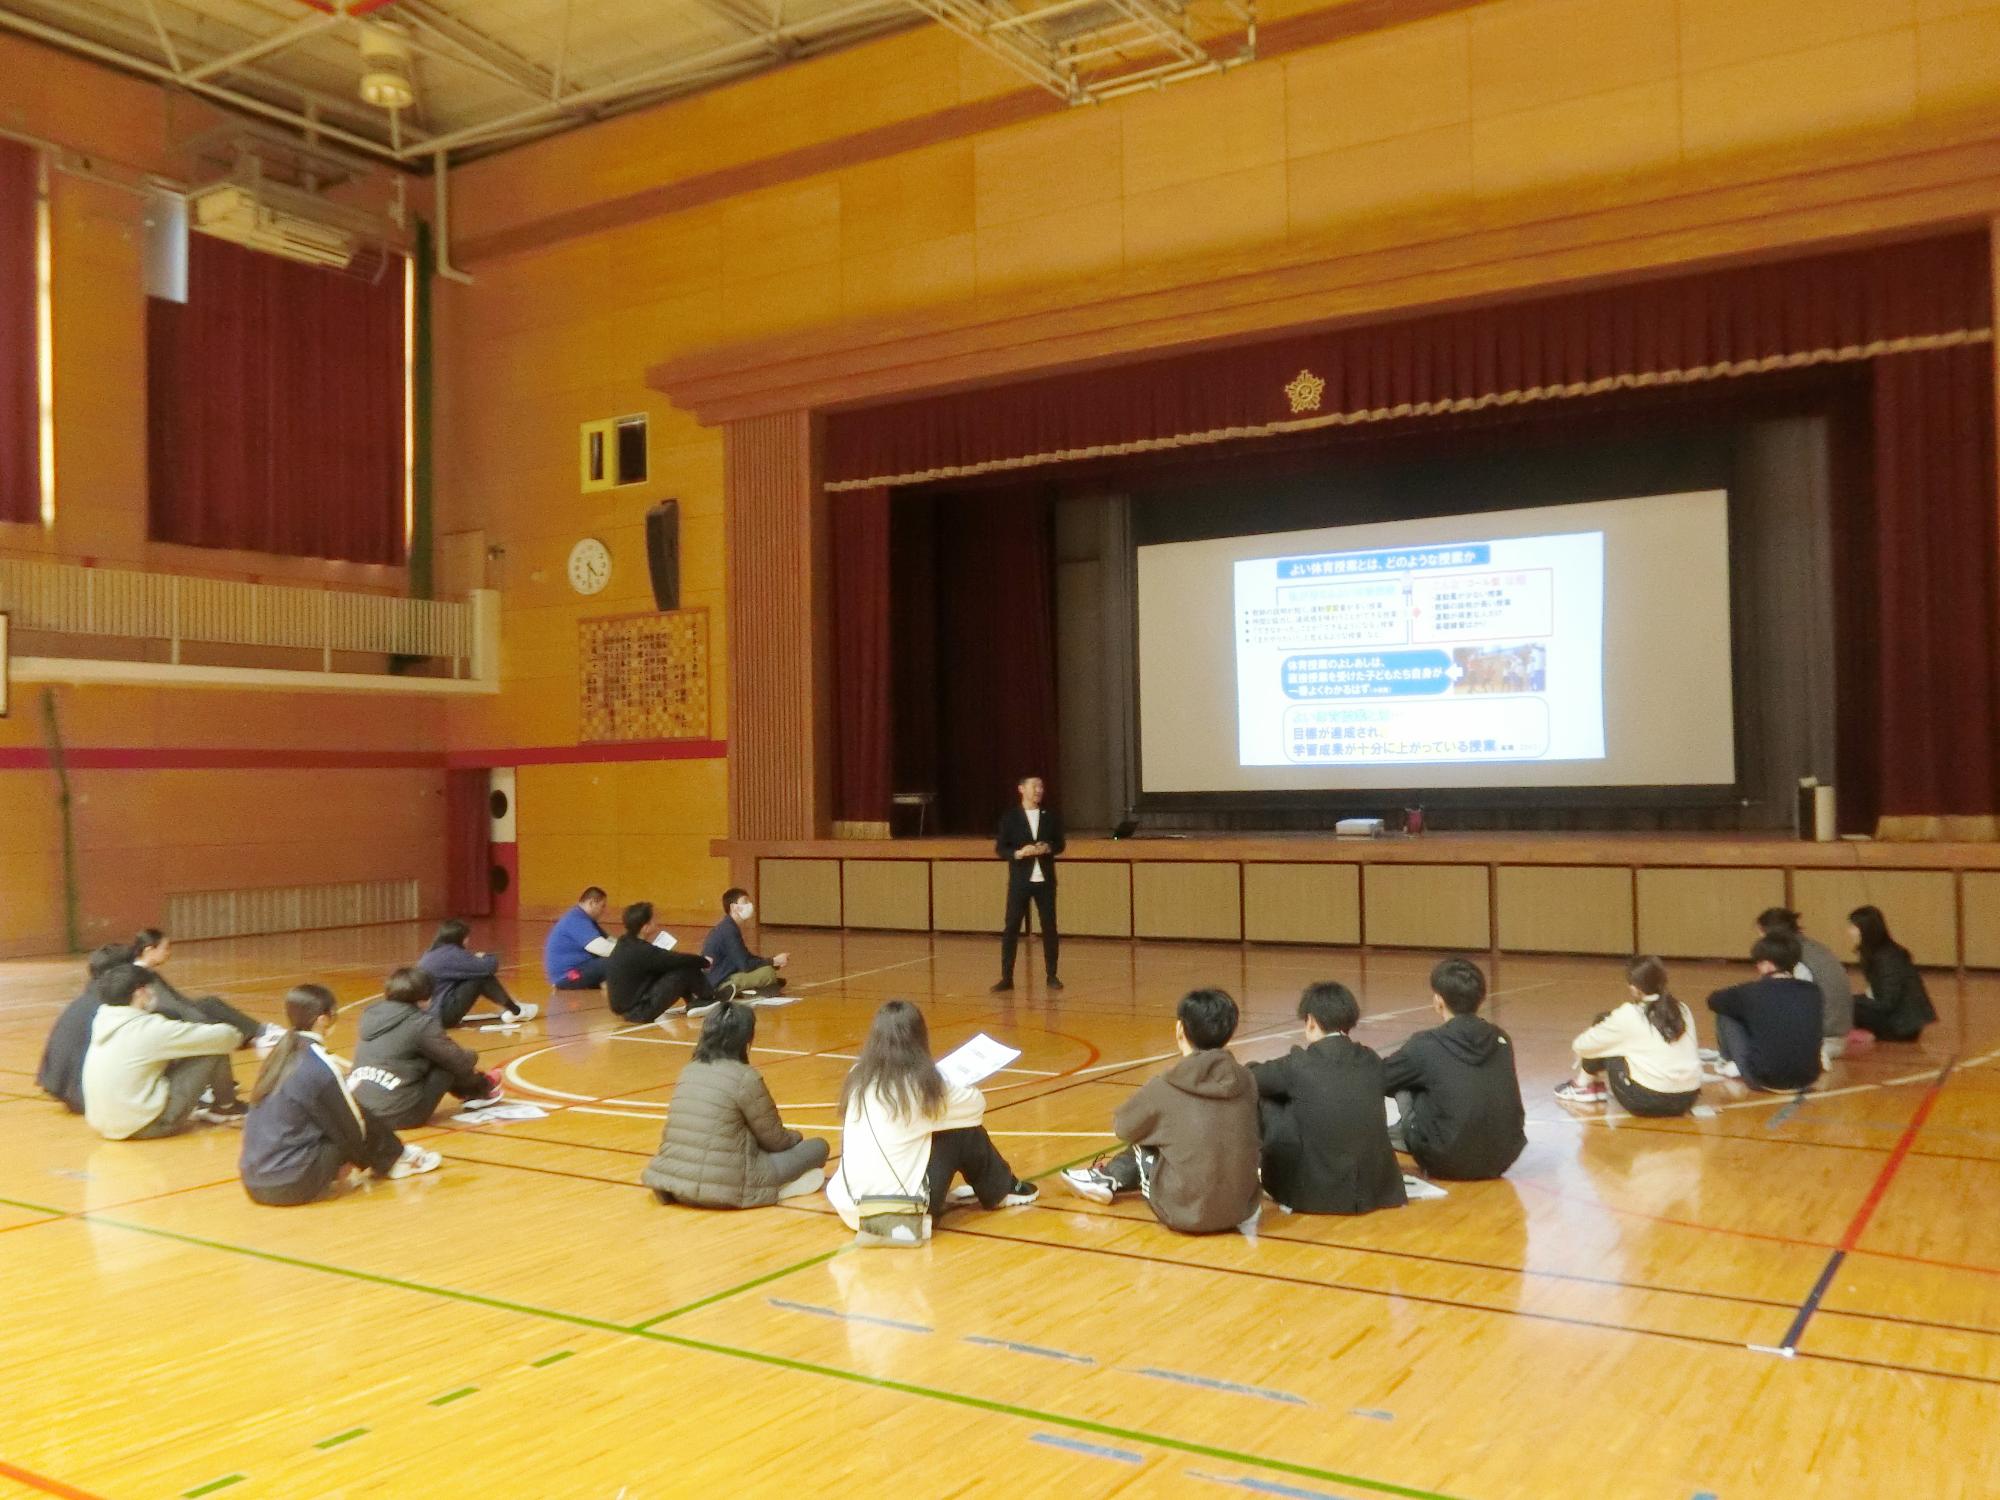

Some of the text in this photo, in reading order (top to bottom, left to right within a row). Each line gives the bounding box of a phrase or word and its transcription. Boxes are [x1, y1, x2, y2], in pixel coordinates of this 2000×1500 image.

[1290, 551, 1476, 576] よい体育授業とは、どのような授業か
[1293, 740, 1497, 756] 学習成果が十分に上がっている授業
